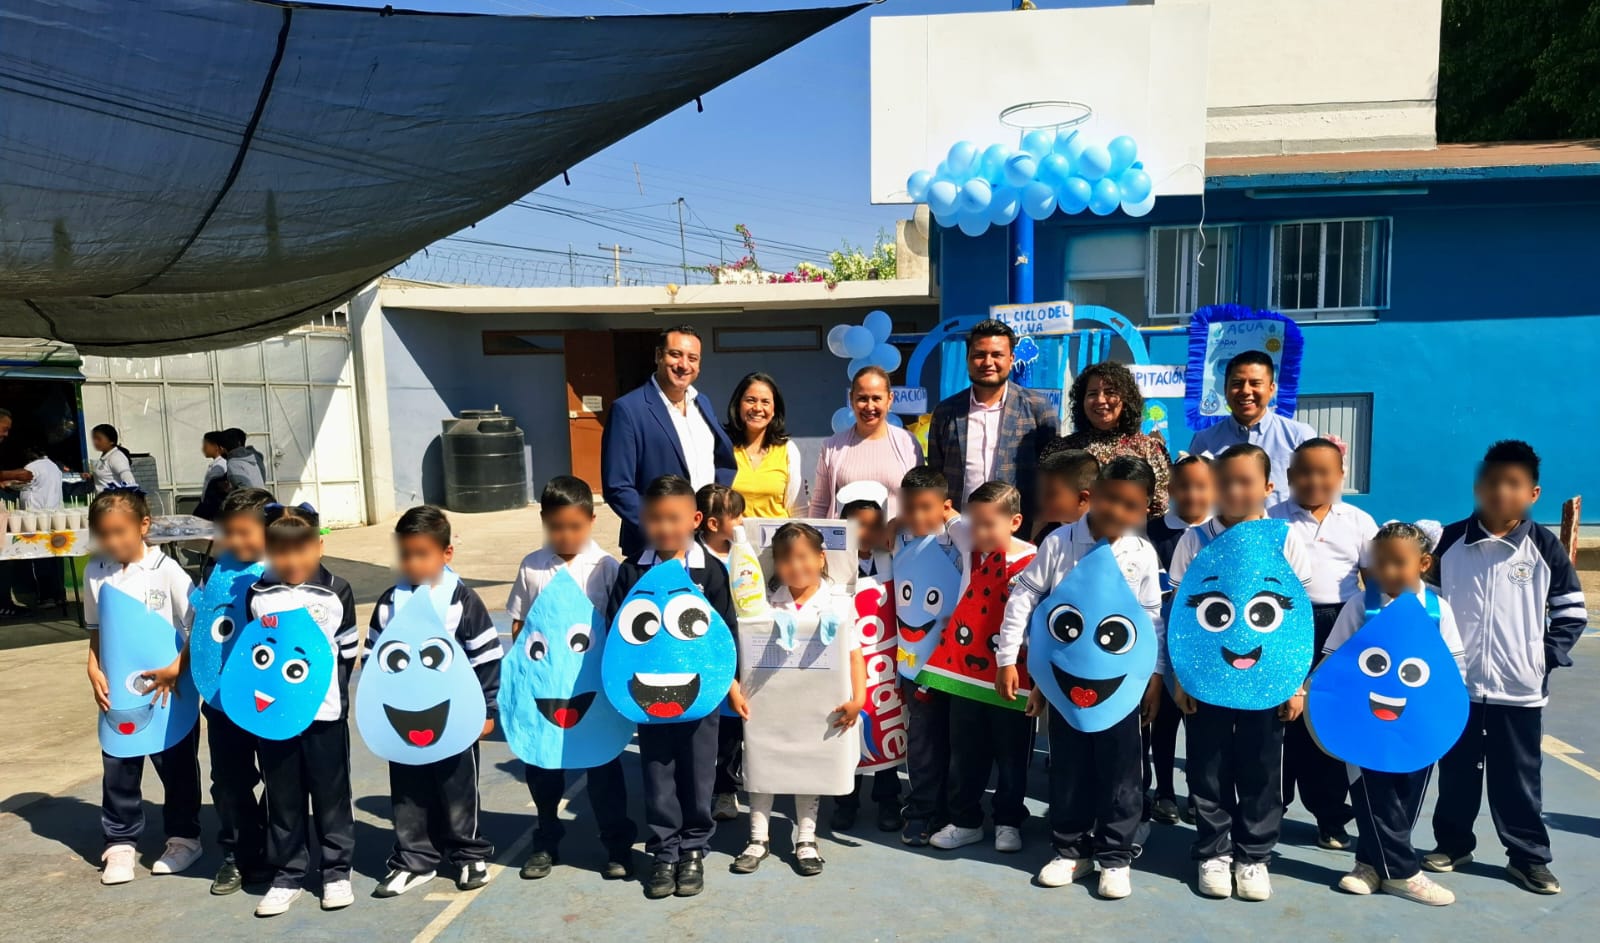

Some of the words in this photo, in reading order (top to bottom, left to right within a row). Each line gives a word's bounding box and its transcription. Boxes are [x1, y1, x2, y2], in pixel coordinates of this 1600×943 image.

[995, 312, 1011, 324] EL
[1012, 322, 1043, 335] AGUA
[1226, 321, 1265, 335] AGUA
[1134, 366, 1188, 387] PITACIÓN
[892, 388, 928, 404] RACIÓN
